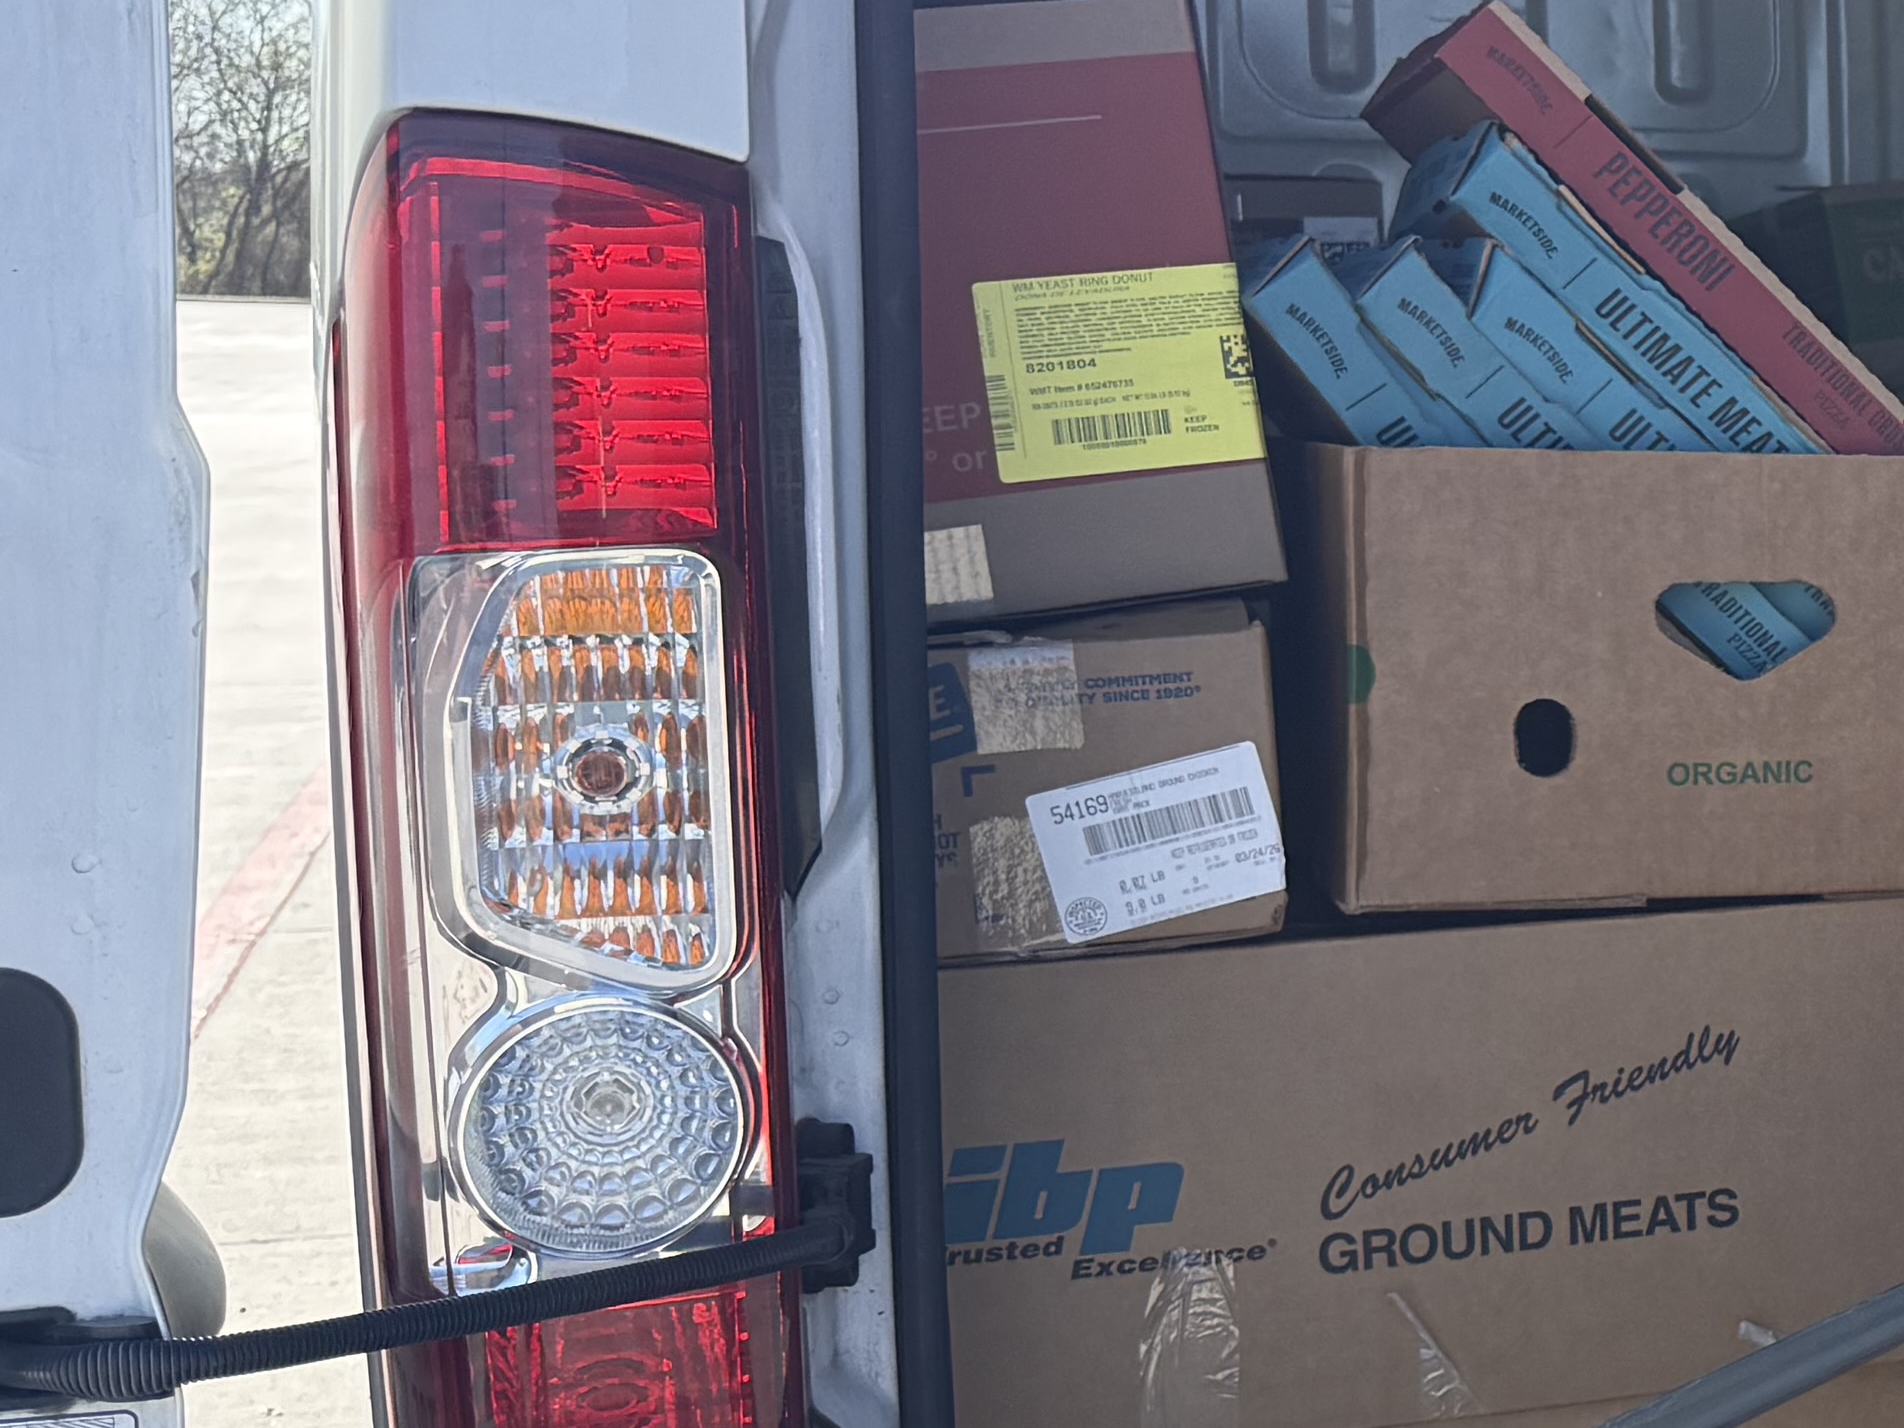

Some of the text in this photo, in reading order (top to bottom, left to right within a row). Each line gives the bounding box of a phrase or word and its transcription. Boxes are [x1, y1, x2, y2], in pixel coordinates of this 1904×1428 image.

[1594, 151, 1736, 292] PEPPERONI
[1037, 277, 1076, 291] YEAST
[1079, 275, 1109, 289] RING
[1112, 272, 1154, 285] DONUT
[1595, 286, 1723, 410] ULTIMATE
[1025, 358, 1098, 374] 8201804
[1782, 321, 1874, 418] TRADITIONAL
[922, 402, 981, 434] EP
[952, 451, 988, 473] or
[1695, 581, 1788, 662] RADITIONAL
[1084, 671, 1195, 690] COMMITMENT
[1102, 687, 1150, 704] SINCE
[1666, 760, 1814, 787] ORGANIC
[1050, 794, 1110, 825] 54169
[1319, 1023, 1742, 1222] Consumer Friendly
[944, 1138, 1185, 1257] ibp
[1317, 1187, 1742, 1276] GROUND MEATS
[946, 1235, 1065, 1267] rusted
